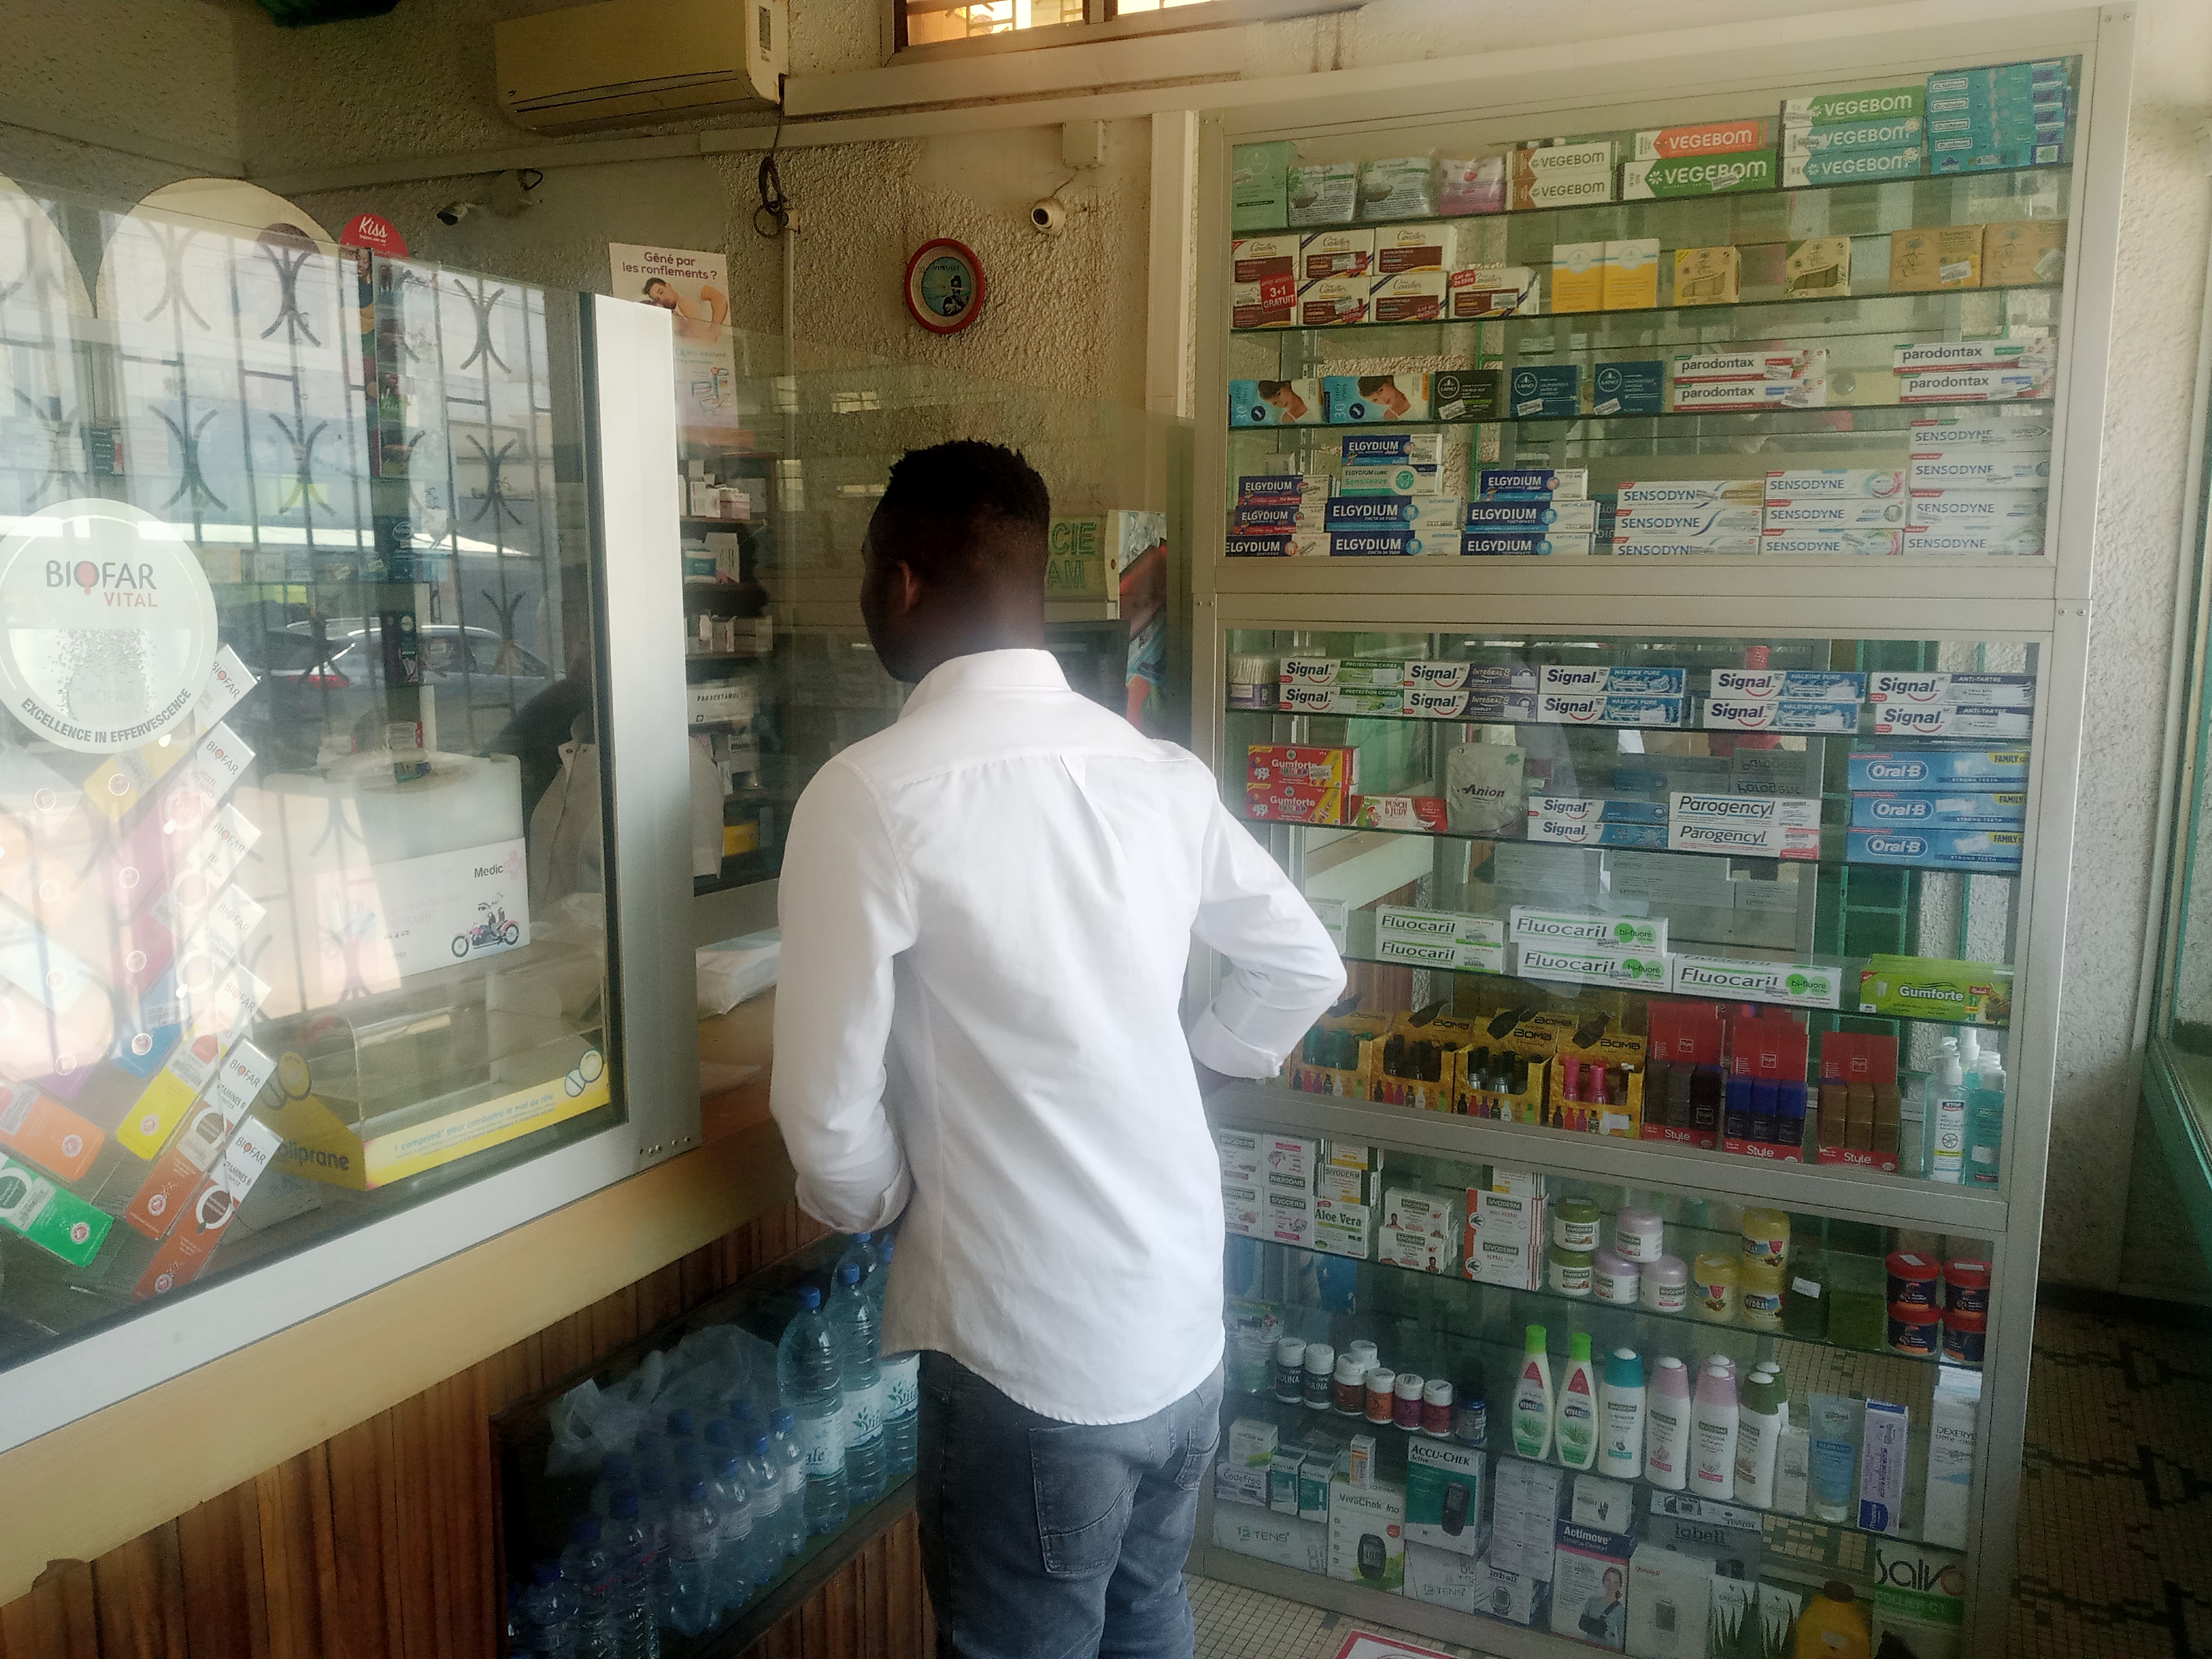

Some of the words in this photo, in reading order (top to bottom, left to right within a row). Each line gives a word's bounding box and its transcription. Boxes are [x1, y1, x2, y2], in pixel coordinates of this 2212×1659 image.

[1825, 95, 1912, 117] VEGEBOM
[1669, 130, 1753, 149] VEGEBOM
[1541, 152, 1604, 168] VEGEBOM
[1822, 154, 1909, 175] VEGEBOM
[1665, 160, 1766, 185] VEGEBOM
[1541, 182, 1605, 197] VEGEBOM
[359, 216, 388, 238] Kiss
[644, 252, 674, 265] Gêné
[676, 256, 696, 266] par
[622, 262, 639, 273] les
[641, 265, 708, 279] ronflements
[710, 270, 717, 280] ?
[1270, 285, 1286, 297] 3+1
[1263, 294, 1295, 309] GRATUIT
[1903, 347, 1982, 363] parodontax
[1681, 358, 1754, 373] parodontax
[1909, 376, 1989, 392] parodontax
[1682, 387, 1755, 401] parodontax
[1335, 403, 1346, 418] 30
[1349, 441, 1398, 451] ELGYDIUM
[1245, 482, 1292, 492] ELGYDIUM
[1488, 476, 1542, 487] ELGYDIUM
[1771, 480, 1844, 490] SENSODYNE
[1333, 505, 1398, 517] ELGYDIUM
[1472, 508, 1537, 521] ELGYDIUM
[1771, 509, 1845, 520] SENSODYNE
[1917, 503, 1994, 513] SENSODYNE
[1242, 511, 1288, 521] ELGYDIUM
[1622, 518, 1700, 528] SENSODYNE
[1226, 541, 1280, 553] ELGYDIUM
[1336, 539, 1402, 551] ELGYDIUM
[1468, 540, 1531, 551] ELGYDIUM
[1766, 541, 1840, 551] SENSODYNE
[1908, 539, 1987, 549] SENSODYNE
[46, 559, 157, 596] BIOFAR
[104, 591, 157, 608] VITAL
[1286, 661, 1329, 677] Signal
[1411, 665, 1457, 681] Signal
[1504, 668, 1511, 677] 8
[212, 661, 240, 699] BIOFAR
[1547, 669, 1597, 685] Signal
[1718, 673, 1772, 689] Signal
[1878, 677, 1936, 694] Signal
[1286, 689, 1329, 703] Signal
[1410, 693, 1457, 709] Signal
[1503, 696, 1510, 705] 8
[1544, 698, 1594, 714] Signal
[1711, 702, 1765, 719] Signal
[21, 697, 92, 743] EXCELLENCE
[95, 731, 107, 743] IN
[110, 687, 191, 743] EFFERVESCENCE
[1883, 708, 1941, 726] Signal
[206, 741, 239, 775] BIOFAR
[1271, 759, 1317, 769] Gumforte
[199, 768, 216, 787] MULTI
[1279, 767, 1309, 776] JUNIOR
[1872, 765, 1921, 777] Oral-B
[1464, 784, 1505, 798] Anion
[1270, 796, 1316, 807] Gumforte
[1544, 799, 1587, 813] Signal
[1679, 796, 1775, 819] Parogencyl
[1876, 803, 1926, 816] Oral-B
[1543, 822, 1586, 835] Signal
[1680, 825, 1766, 844] Parogencyl
[213, 822, 245, 856] BIOFAR
[1872, 839, 1921, 853] Oral-B
[208, 852, 220, 866] FER
[474, 864, 504, 878] Medic
[218, 902, 250, 934] BIOFAR
[1382, 914, 1455, 934] Fluocaril
[1516, 917, 1607, 939] Fluocaril
[1620, 928, 1652, 938] bi-fluoré
[1381, 942, 1455, 960] Fluocaril
[1524, 952, 1615, 973] Fluocaril
[1681, 968, 1778, 987] Fluocaril
[1792, 980, 1826, 989] bi-fluoré
[225, 982, 256, 1013] BIOFAR
[1899, 984, 1964, 1003] Gumforte
[1432, 1019, 1471, 1030] BOMB
[1534, 1016, 1573, 1027] BOMB
[1513, 1028, 1552, 1041] BOMB
[1601, 1038, 1641, 1051] BOMB
[229, 1059, 261, 1088] BIOFAR
[447, 1124, 465, 1136] pour
[467, 1110, 504, 1129] combattre
[515, 1101, 529, 1112] mal
[531, 1097, 539, 1107] de
[541, 1093, 554, 1103] tête
[1664, 1128, 1691, 1142] Style
[1220, 1137, 1254, 1149] SIVODERM
[236, 1136, 266, 1165] BIOFAR
[1747, 1144, 1775, 1159] Style
[1844, 1152, 1872, 1164] Style
[1326, 1168, 1360, 1178] SIVODERM
[1271, 1197, 1305, 1208] SIVODERM
[1402, 1201, 1429, 1210] SIVODERM
[1488, 1199, 1521, 1209] SIVODERM
[1315, 1209, 1337, 1222] Aloe
[1340, 1212, 1362, 1227] Vera
[1397, 1235, 1425, 1244] SIVODERM
[1484, 1244, 1518, 1254] SIVODERM
[1410, 1453, 1430, 1464] Active
[1411, 1444, 1471, 1467] ACCU-CHEK
[1386, 1503, 1400, 1514] Ino
[1563, 1526, 1609, 1545] Actimove
